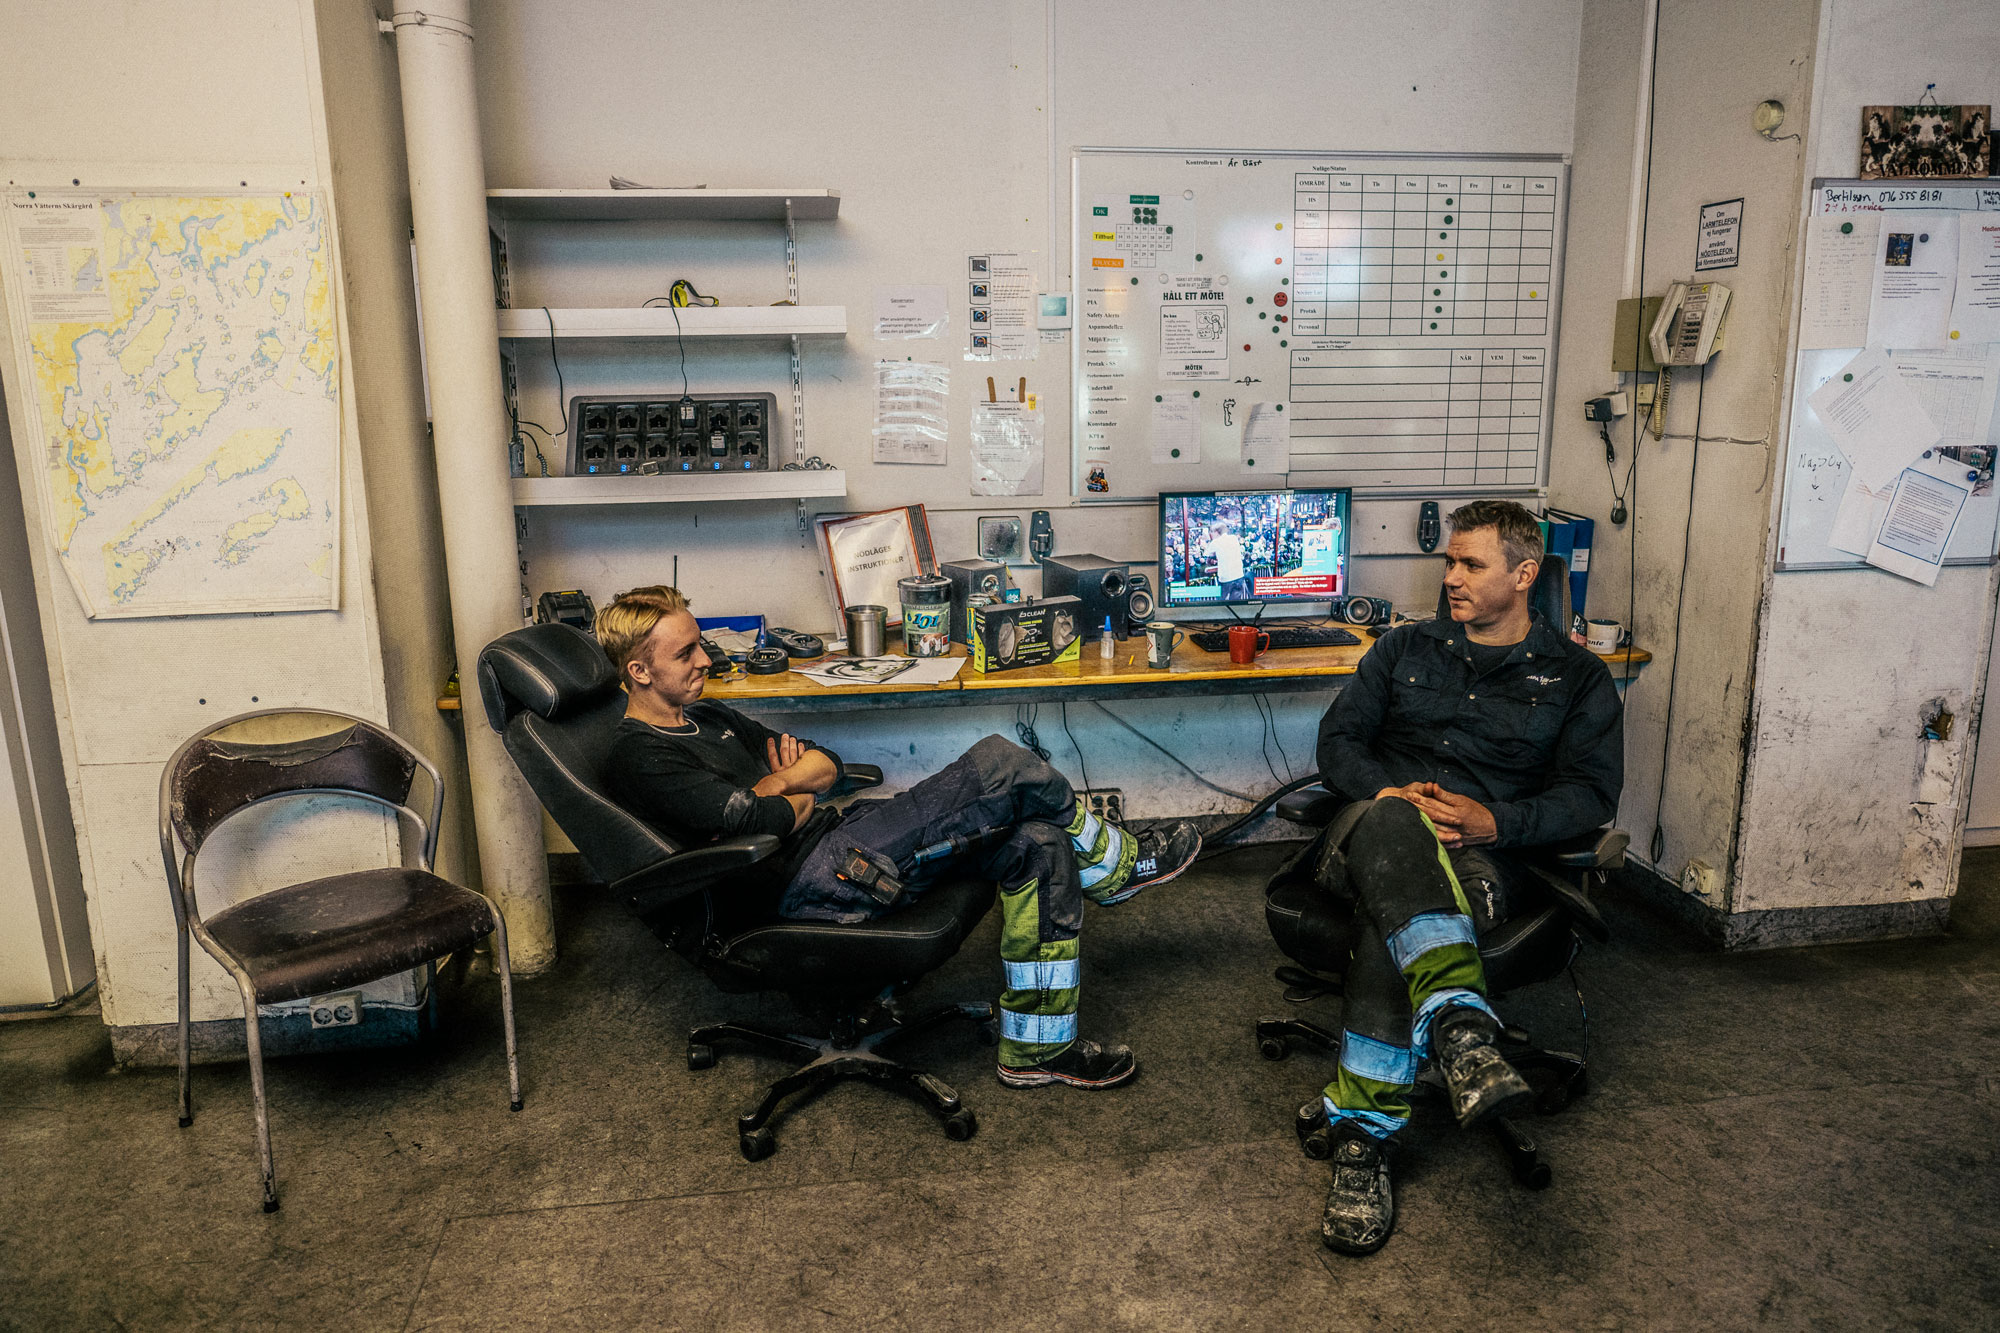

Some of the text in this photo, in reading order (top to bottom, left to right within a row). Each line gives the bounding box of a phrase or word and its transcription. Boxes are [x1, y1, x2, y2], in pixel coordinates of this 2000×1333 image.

[1879, 190, 1896, 203] 076
[1898, 191, 1915, 201] 555
[1919, 190, 1943, 201] 8181
[62, 202, 93, 210] Skärgård
[1095, 208, 1106, 216] OK
[1702, 217, 1738, 230] LARMTELEFON
[1163, 289, 1224, 301] HÅLL ETT MÖTE!
[1184, 363, 1203, 371] MÖTEN
[912, 613, 940, 630] 101
